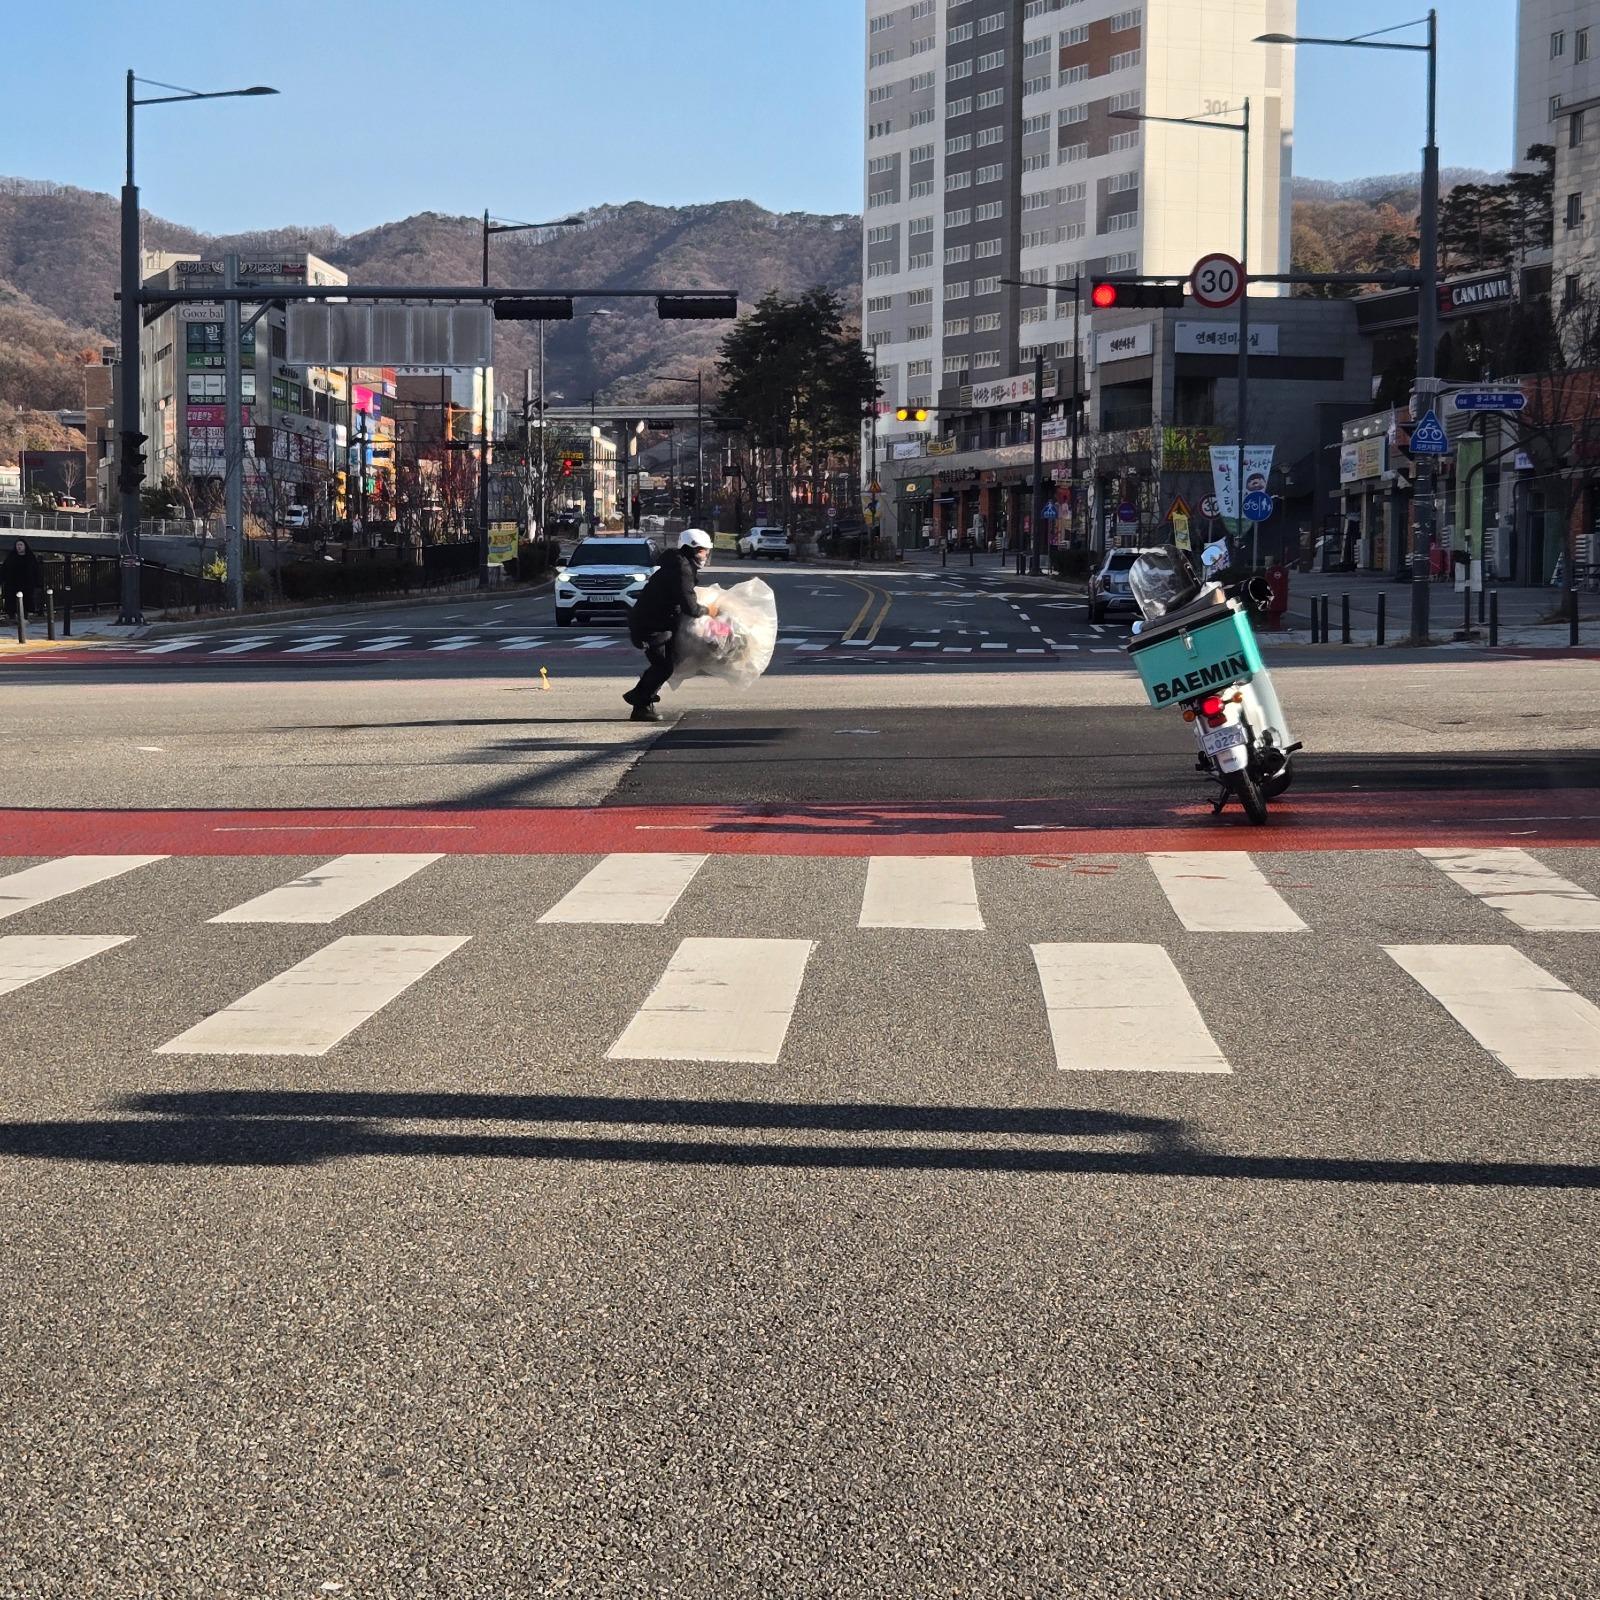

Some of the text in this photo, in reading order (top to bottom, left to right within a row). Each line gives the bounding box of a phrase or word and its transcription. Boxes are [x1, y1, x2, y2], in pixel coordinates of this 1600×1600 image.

[1203, 99, 1228, 117] 301
[1201, 269, 1234, 293] 30
[1452, 279, 1512, 306] CANTAVIL
[1195, 330, 1260, 347] 연혜진미실
[1203, 500, 1220, 513] 30
[1152, 654, 1250, 703] BAEMIN
